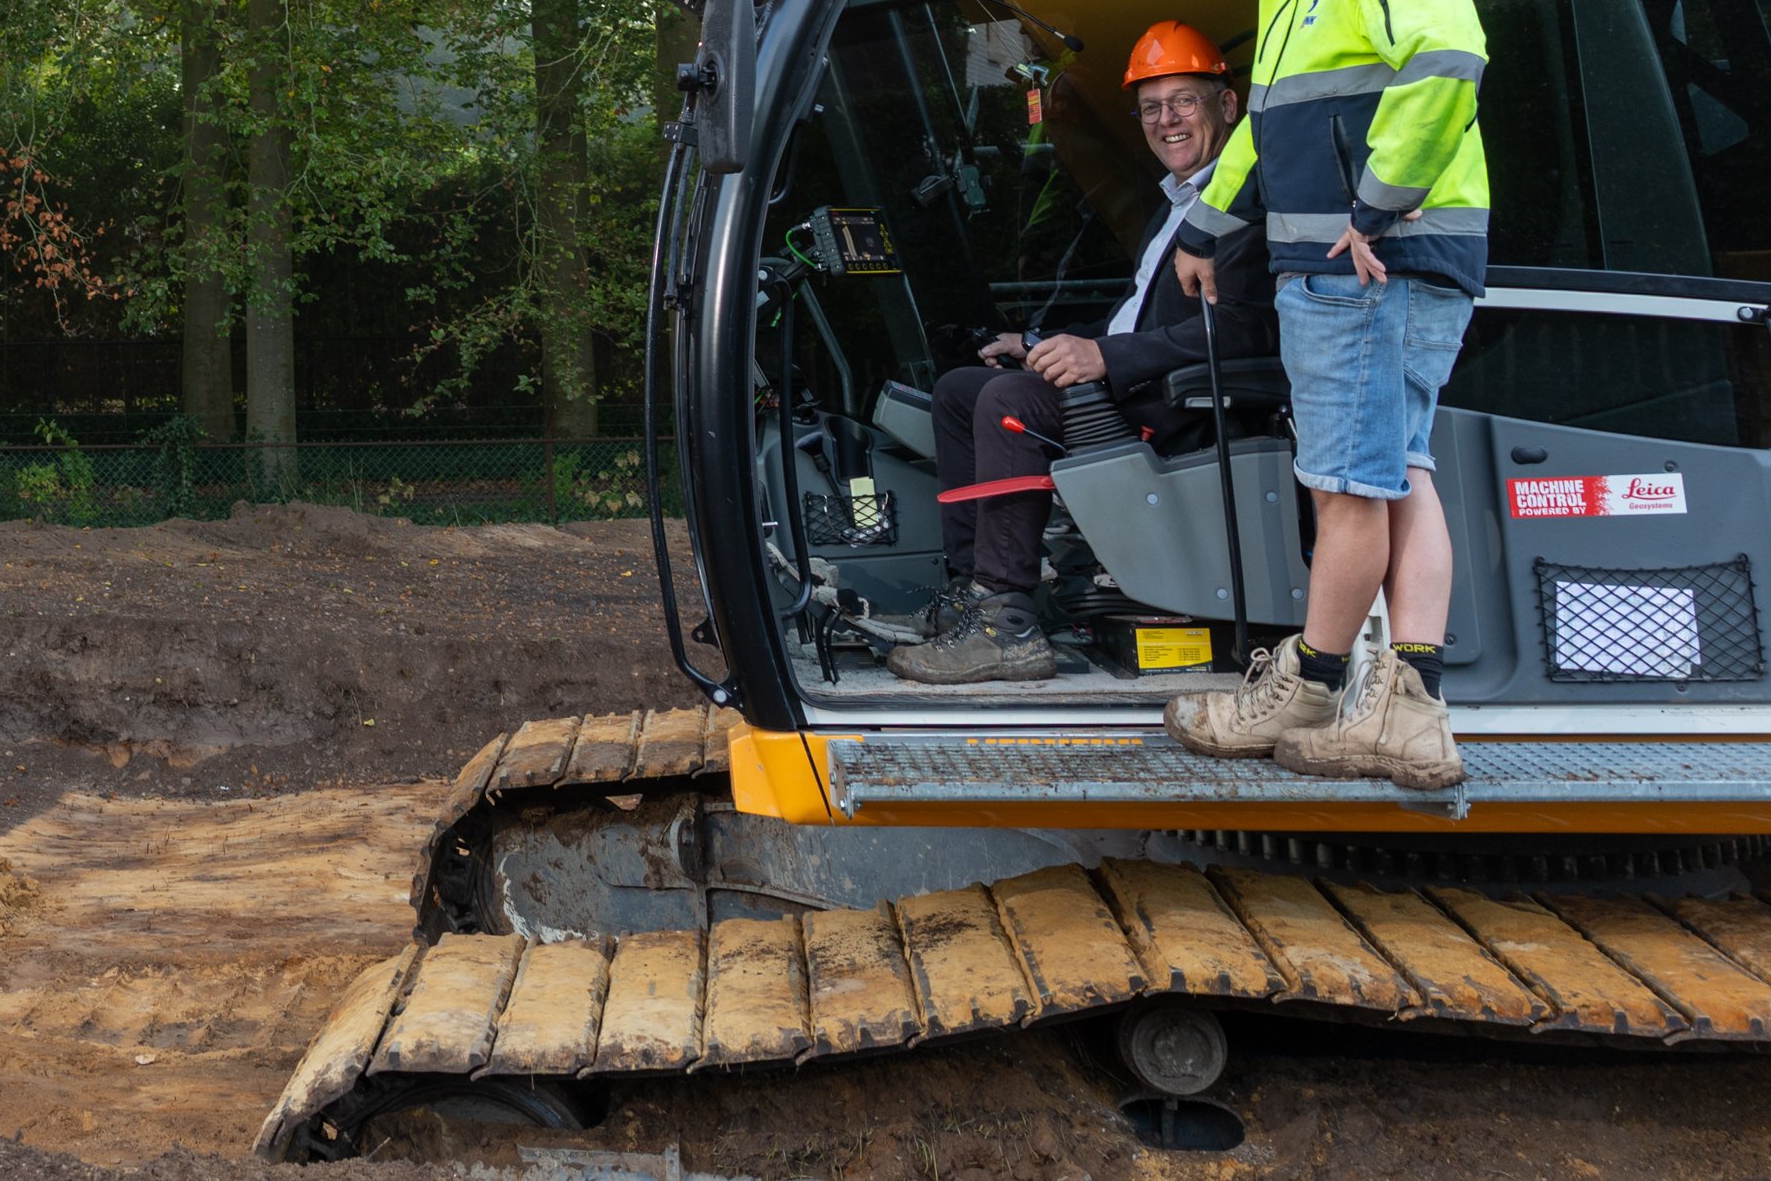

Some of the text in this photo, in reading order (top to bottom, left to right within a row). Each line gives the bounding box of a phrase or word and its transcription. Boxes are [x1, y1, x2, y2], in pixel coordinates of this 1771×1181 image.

[1514, 479, 1585, 494] MACHINE
[1621, 477, 1677, 501] Leica
[1516, 492, 1587, 509] CONTROL
[1628, 501, 1673, 511] Geosystems
[1518, 506, 1587, 517] POWERED BY
[1392, 643, 1437, 655] WORK
